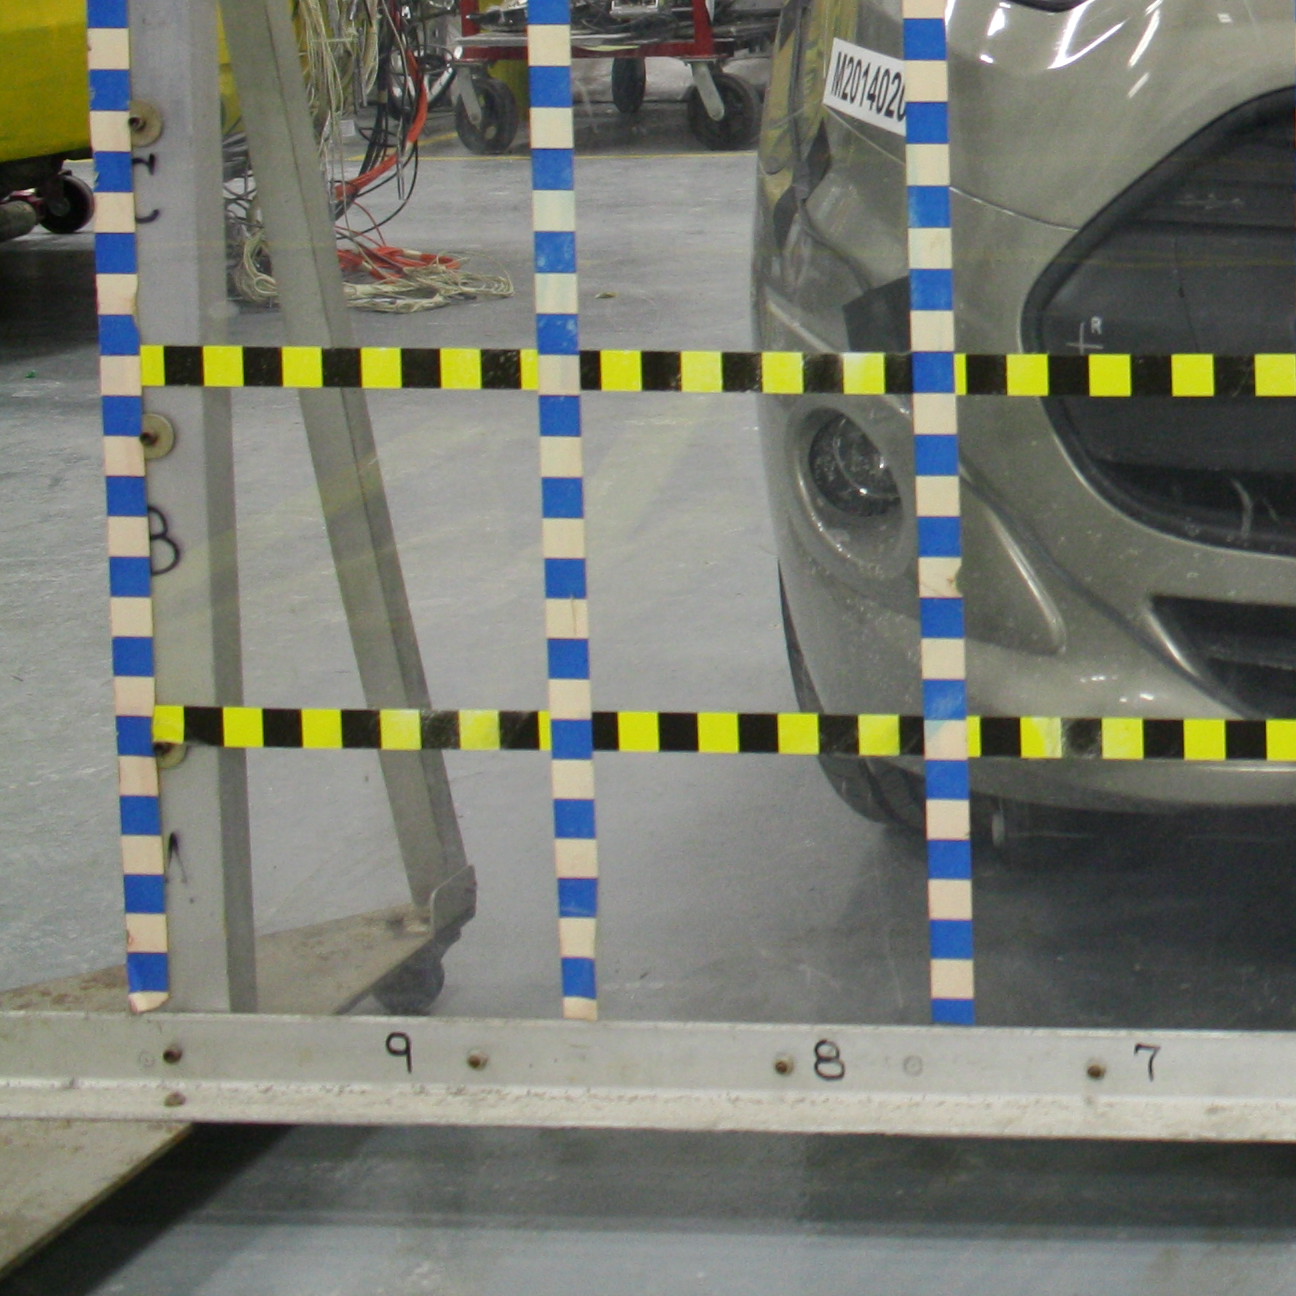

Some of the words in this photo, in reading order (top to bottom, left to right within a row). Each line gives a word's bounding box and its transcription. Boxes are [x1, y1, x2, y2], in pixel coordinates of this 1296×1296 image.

[830, 50, 906, 123] M2014020
[1090, 315, 1103, 336] R
[385, 1031, 412, 1074] 9
[813, 1038, 846, 1082] 8
[1133, 1043, 1161, 1082] 7
